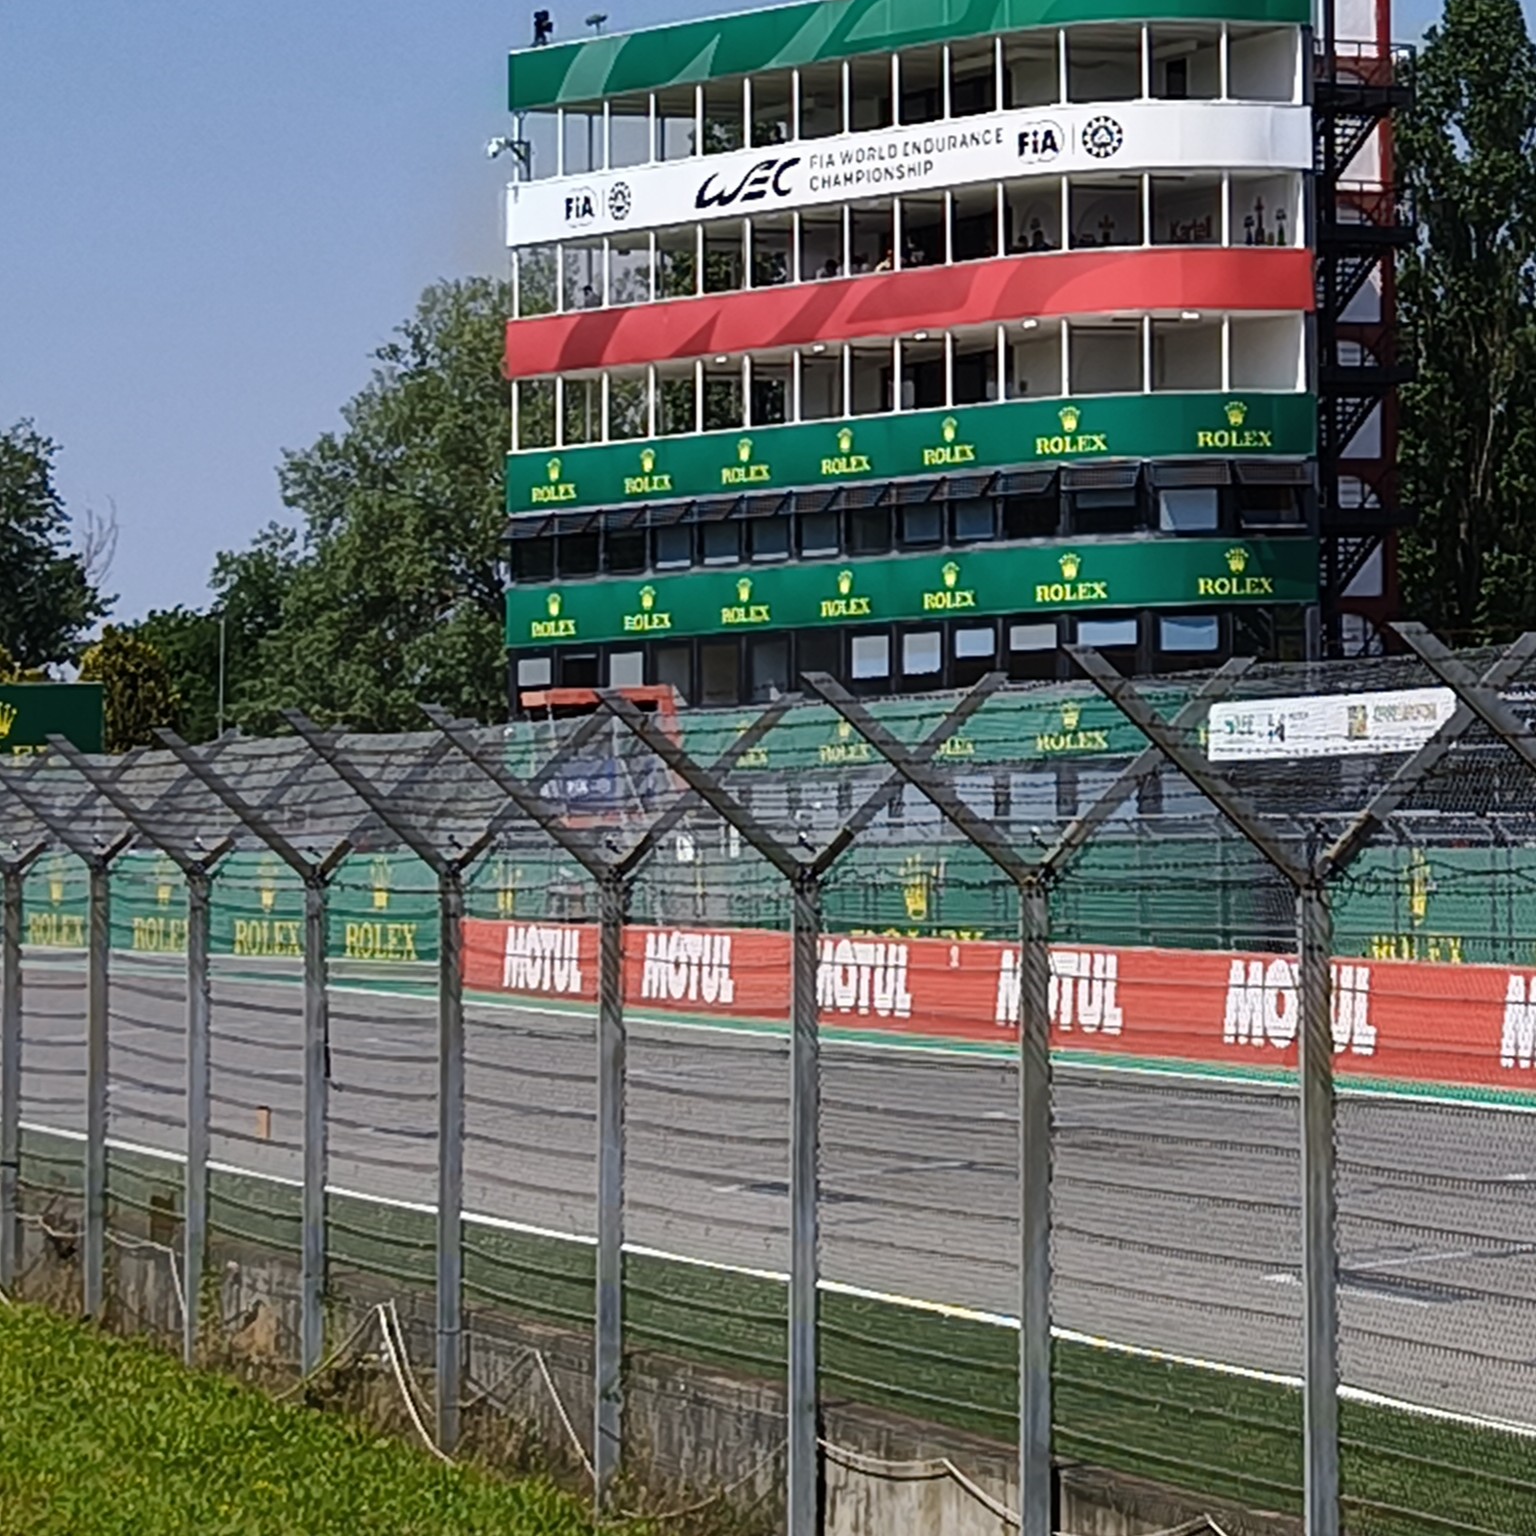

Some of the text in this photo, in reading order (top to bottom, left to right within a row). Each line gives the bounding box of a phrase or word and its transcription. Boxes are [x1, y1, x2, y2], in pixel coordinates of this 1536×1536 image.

[810, 127, 1004, 169] FIA WORLD ENDURANCE
[695, 157, 801, 209] WEC
[809, 160, 934, 192] CHAMPIONSHIP
[1036, 434, 1108, 456] ROLEX
[1197, 429, 1272, 449] ROLEX
[821, 455, 871, 476] ROLEX
[923, 443, 975, 466] ROLEX
[1036, 581, 1108, 603] ROLEX
[1198, 576, 1274, 596] ROLEX
[820, 596, 871, 618] ROLEX
[923, 589, 976, 610] ROLEX
[1036, 730, 1109, 752] ROLEX
[132, 916, 188, 951] ROLE
[344, 922, 418, 960] ROLEX
[503, 925, 582, 993] MOTUL
[641, 931, 735, 1004] MOTUL
[1223, 959, 1377, 1056] MOUL
